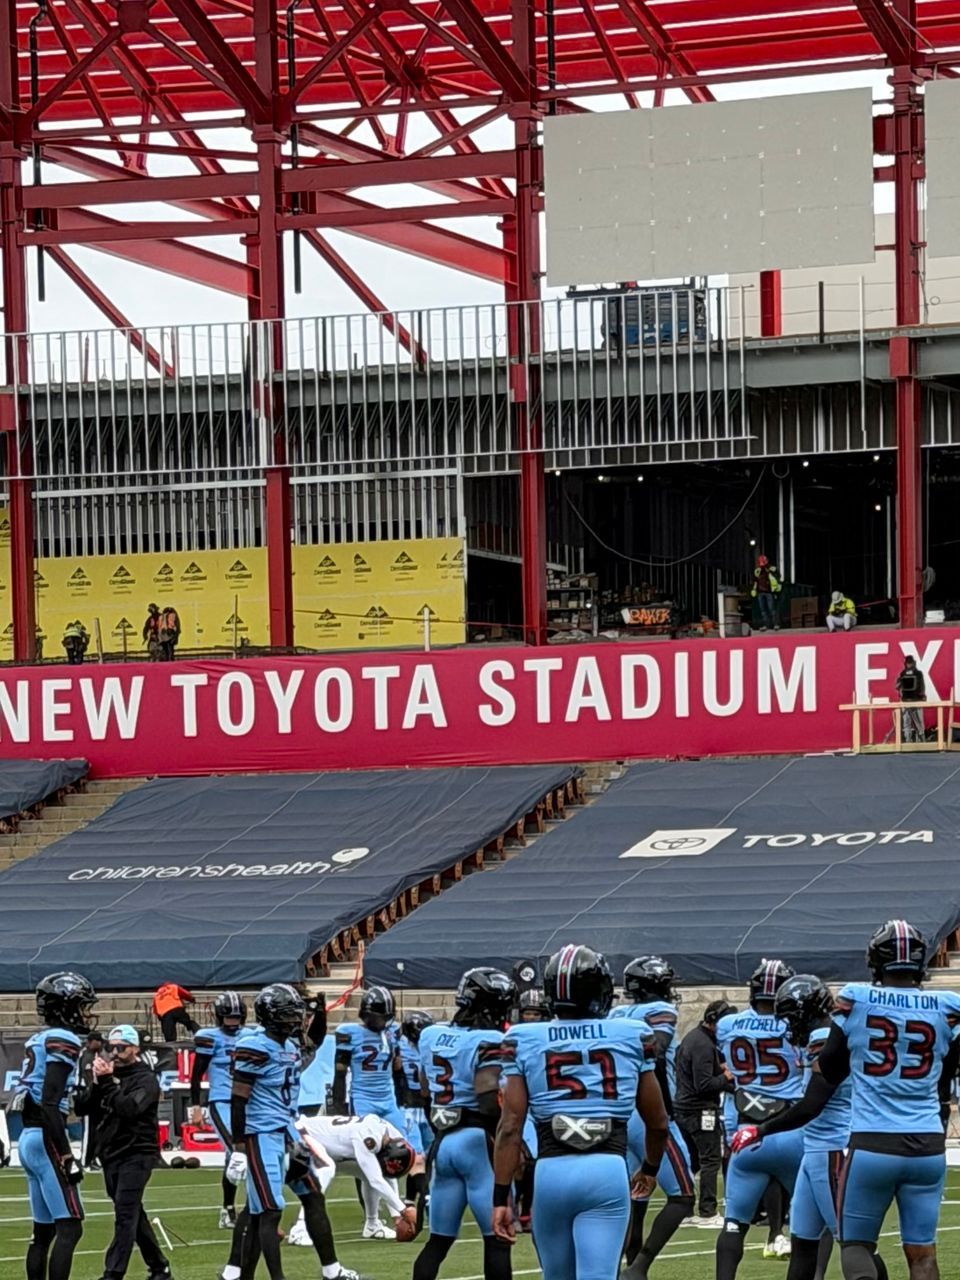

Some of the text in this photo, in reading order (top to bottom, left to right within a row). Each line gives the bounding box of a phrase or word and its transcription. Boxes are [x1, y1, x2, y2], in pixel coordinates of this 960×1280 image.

[0, 675, 145, 743] NEW
[170, 664, 448, 738] TOYOTA
[478, 645, 817, 727] STADIUM
[742, 829, 935, 849] TOYOTA
[868, 989, 940, 1011] CHARLTON
[548, 1023, 608, 1043] DOWELL
[731, 1018, 782, 1032] MITCHELL
[729, 1036, 791, 1087] 95
[862, 1014, 936, 1080] 33
[544, 1049, 618, 1101] 51
